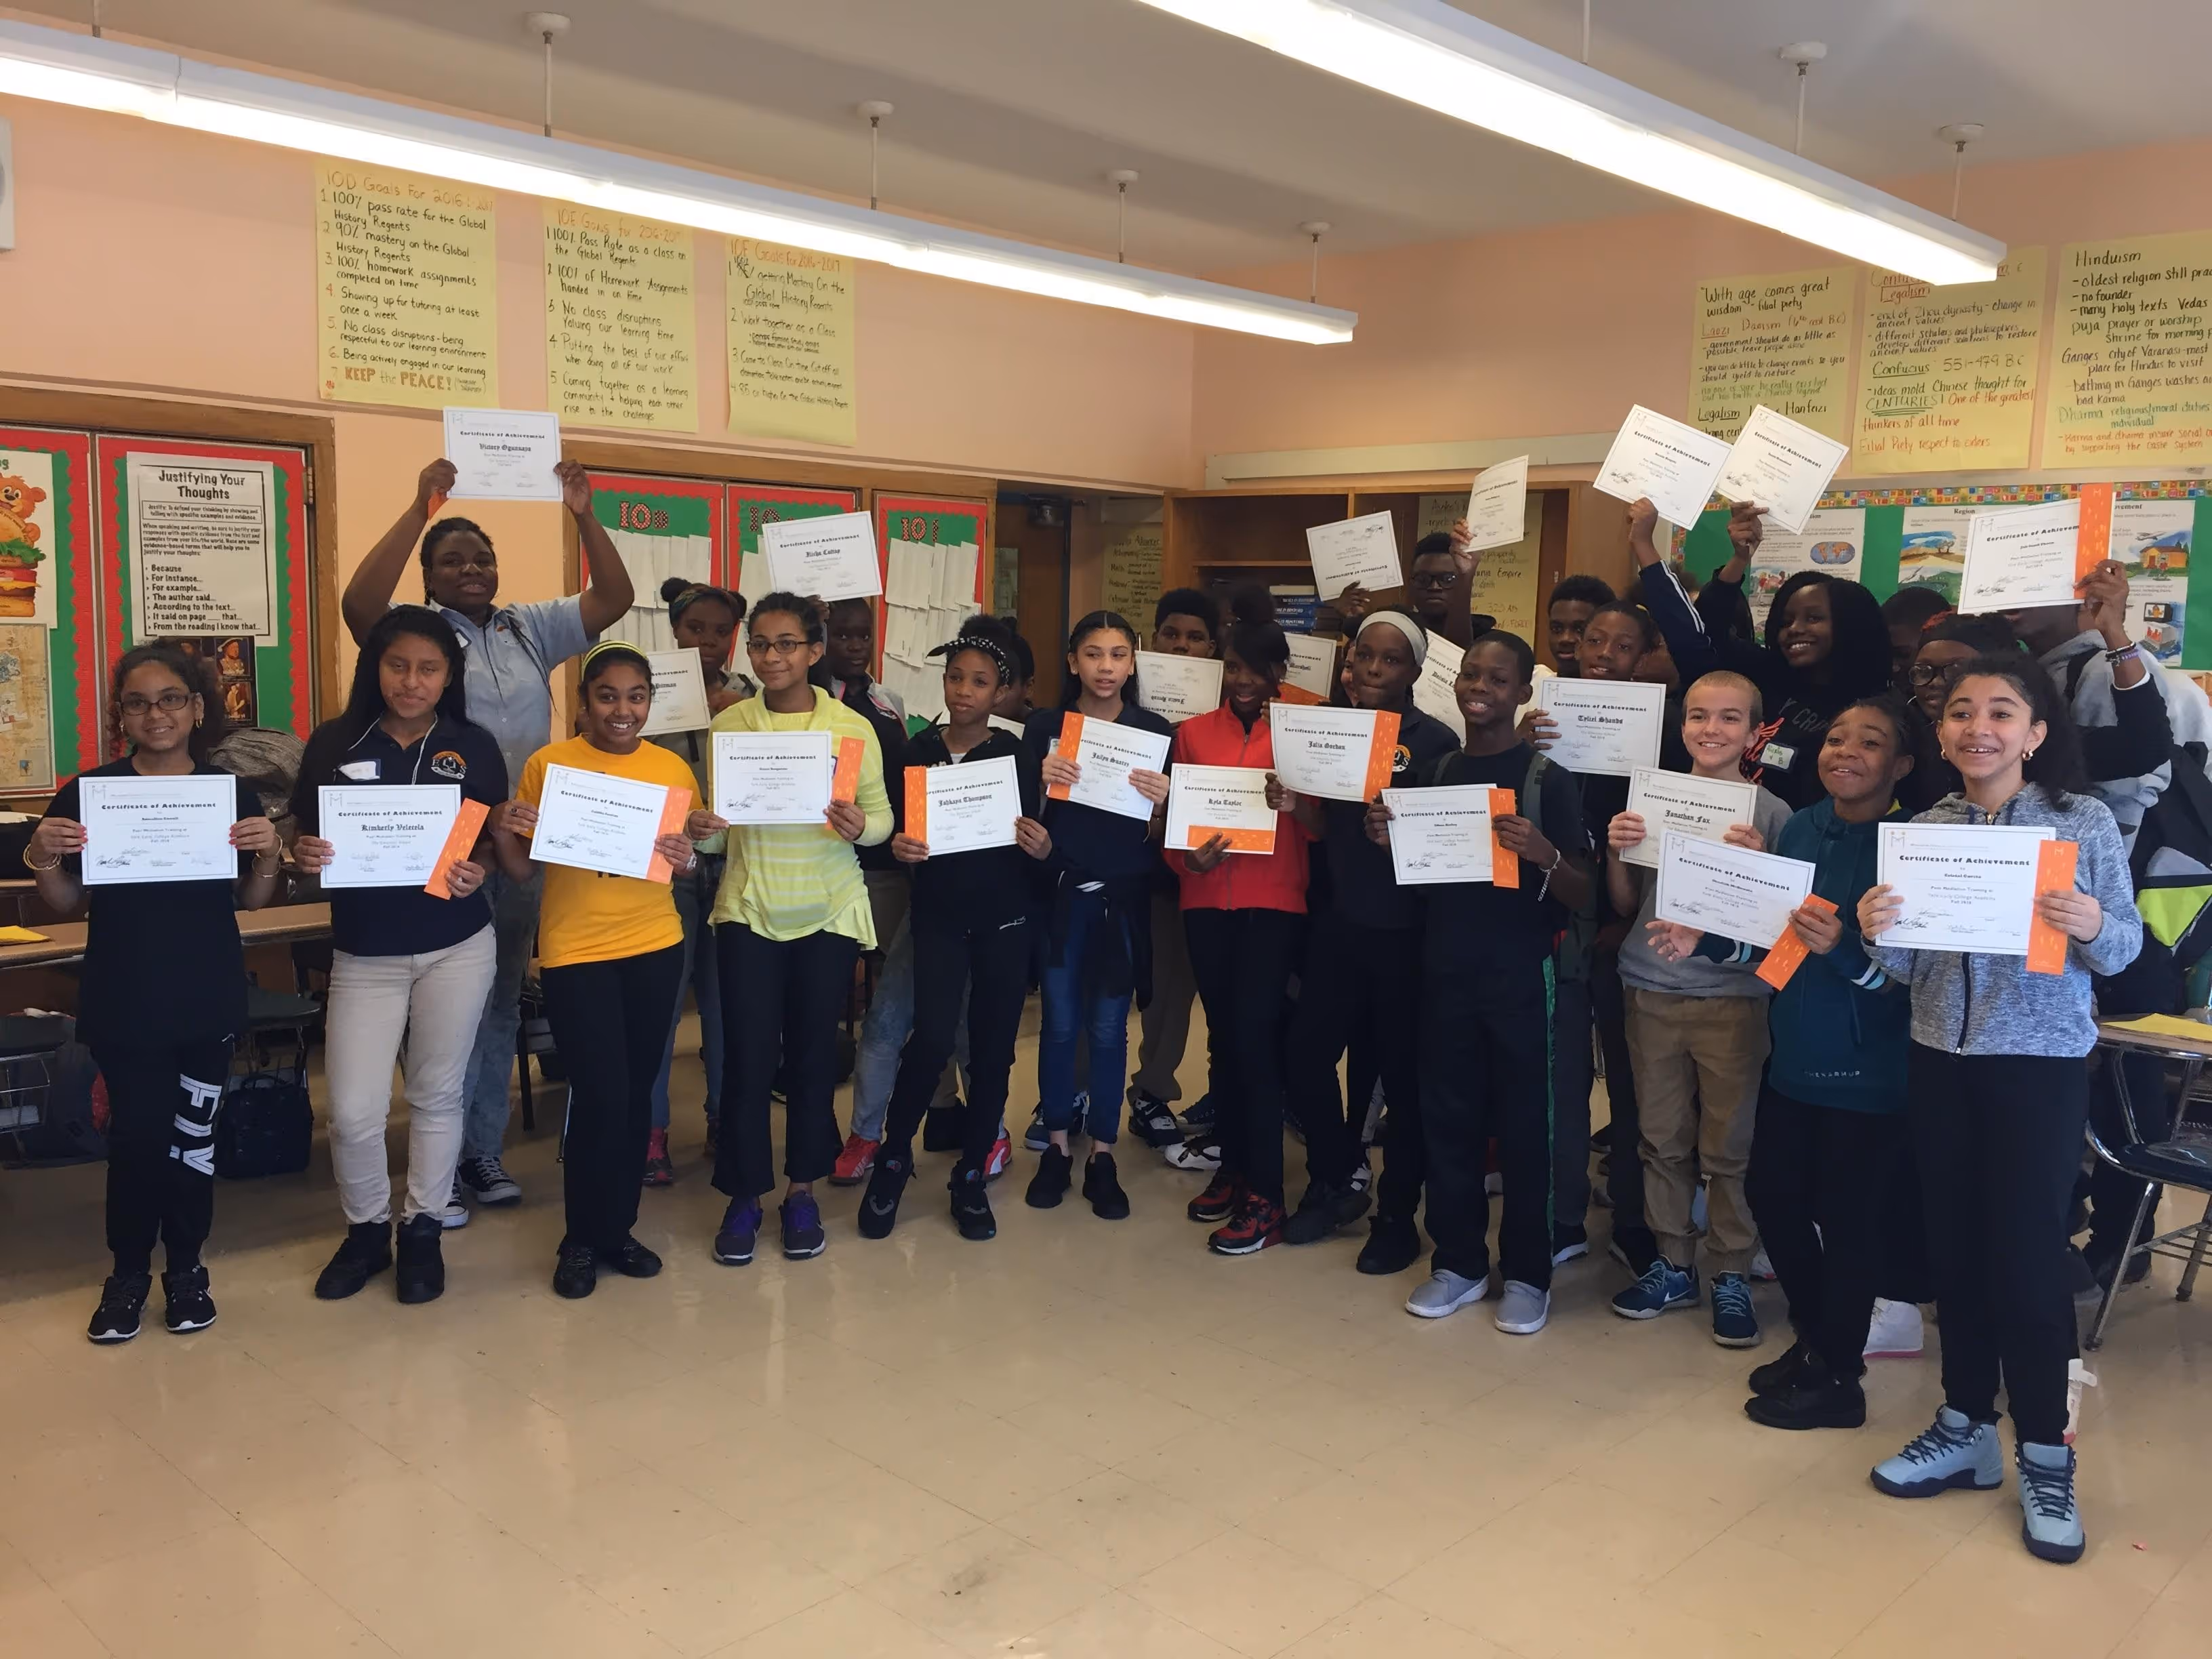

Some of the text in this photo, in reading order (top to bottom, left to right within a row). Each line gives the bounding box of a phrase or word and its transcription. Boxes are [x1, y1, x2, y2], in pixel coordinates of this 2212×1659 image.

[363, 177, 401, 196] Goals
[333, 191, 486, 230] 100% pass rate for the Global
[334, 209, 410, 232] History Regents
[335, 222, 469, 257] 90% mastery on the Global
[337, 242, 411, 262] History Regents
[556, 244, 602, 260] the Global
[2076, 250, 2142, 267] Hinduism
[337, 255, 476, 286] 100% homework assignments
[585, 270, 594, 282] of
[2081, 267, 2187, 287] oldest religion still
[337, 271, 419, 289] completed on time
[561, 279, 588, 295] handed
[1738, 276, 1830, 304] age comes great
[1881, 285, 1931, 303] Legalism
[2082, 289, 2133, 302] no founder
[342, 286, 479, 318] Showing up for tutoring at least
[563, 300, 607, 319] No class
[2080, 298, 2207, 318] many holy texts Vedas
[340, 305, 360, 315] once
[375, 311, 398, 320] week
[599, 324, 612, 332] our
[657, 328, 674, 341] time
[2108, 314, 2201, 333] prayer or worship
[344, 320, 464, 348] No class being
[2146, 328, 2204, 342] for morning
[340, 331, 377, 346] respectful
[381, 337, 390, 346] to
[408, 340, 436, 354] learning
[440, 346, 487, 359] environment
[561, 333, 638, 358] Putting best
[343, 348, 367, 363] Being
[370, 354, 396, 366] actively
[401, 358, 429, 371] engaged
[457, 363, 486, 379] learning
[2062, 348, 2098, 364] Ganges
[2131, 357, 2204, 372] Hindus visit
[345, 367, 396, 385] KEEP the
[1873, 362, 1930, 376] Confucius
[600, 375, 630, 396] together
[1902, 375, 2027, 394] mold Chinese thought for
[2166, 375, 2199, 386] washes
[1948, 392, 1966, 405] One
[1970, 394, 1980, 403] of
[1984, 391, 1997, 403] the
[1698, 407, 1740, 422] Legalism
[1864, 415, 1960, 432] thinkers of all time
[1919, 438, 1949, 451] respect
[159, 470, 245, 486] Justifying Your
[178, 486, 230, 499] Thoughts
[1986, 531, 2028, 542] Certificate
[153, 603, 190, 611] According
[188, 623, 215, 631] reading
[1643, 792, 1678, 804] Certificate
[1689, 801, 1736, 813] Achievement
[1965, 857, 2030, 866] Achievement
[1679, 857, 1722, 873] Certificate
[1736, 872, 1790, 891] Achievement
